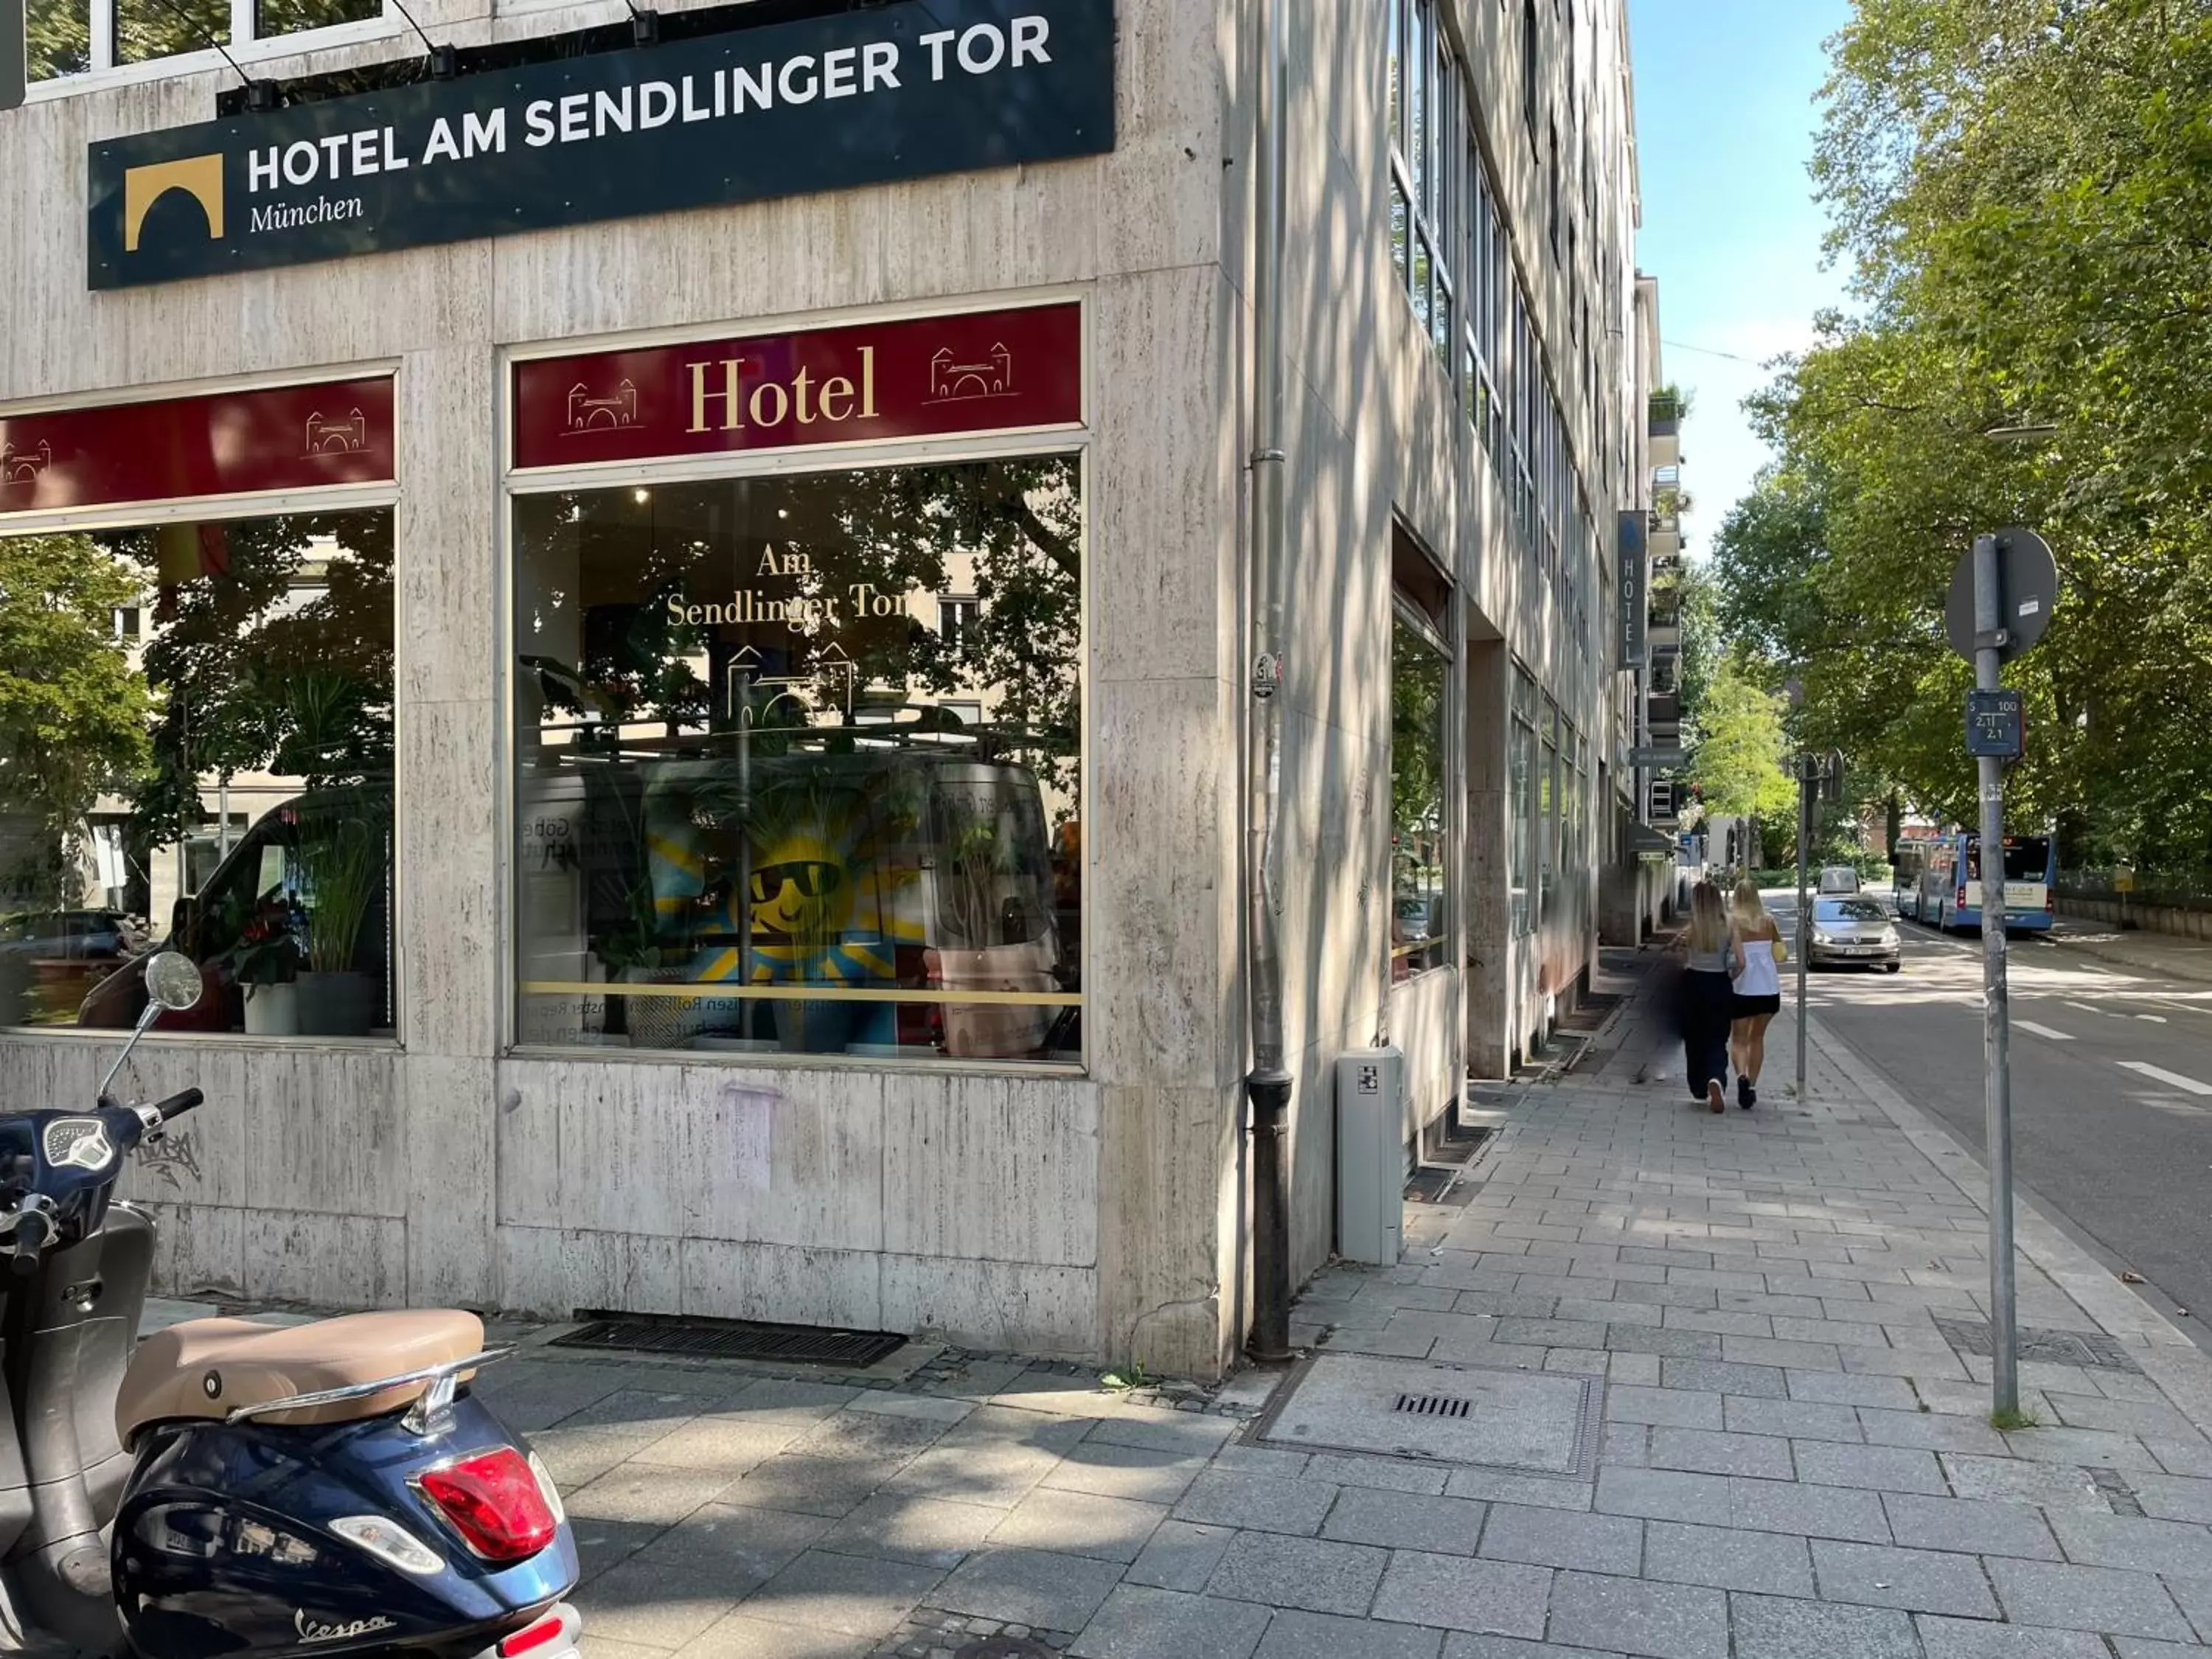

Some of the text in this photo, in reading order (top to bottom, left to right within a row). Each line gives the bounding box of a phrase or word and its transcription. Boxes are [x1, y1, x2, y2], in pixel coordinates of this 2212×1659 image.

[249, 15, 1052, 192] HOTEL AM SENDLINGER TOR
[250, 196, 363, 233] München
[686, 346, 879, 433] Hotel
[756, 543, 812, 577] Am
[667, 583, 908, 633] Sendlinger Tor
[1624, 559, 1634, 663] HOTEL
[1998, 701, 2017, 712] 100
[294, 1607, 398, 1644] Vespa
